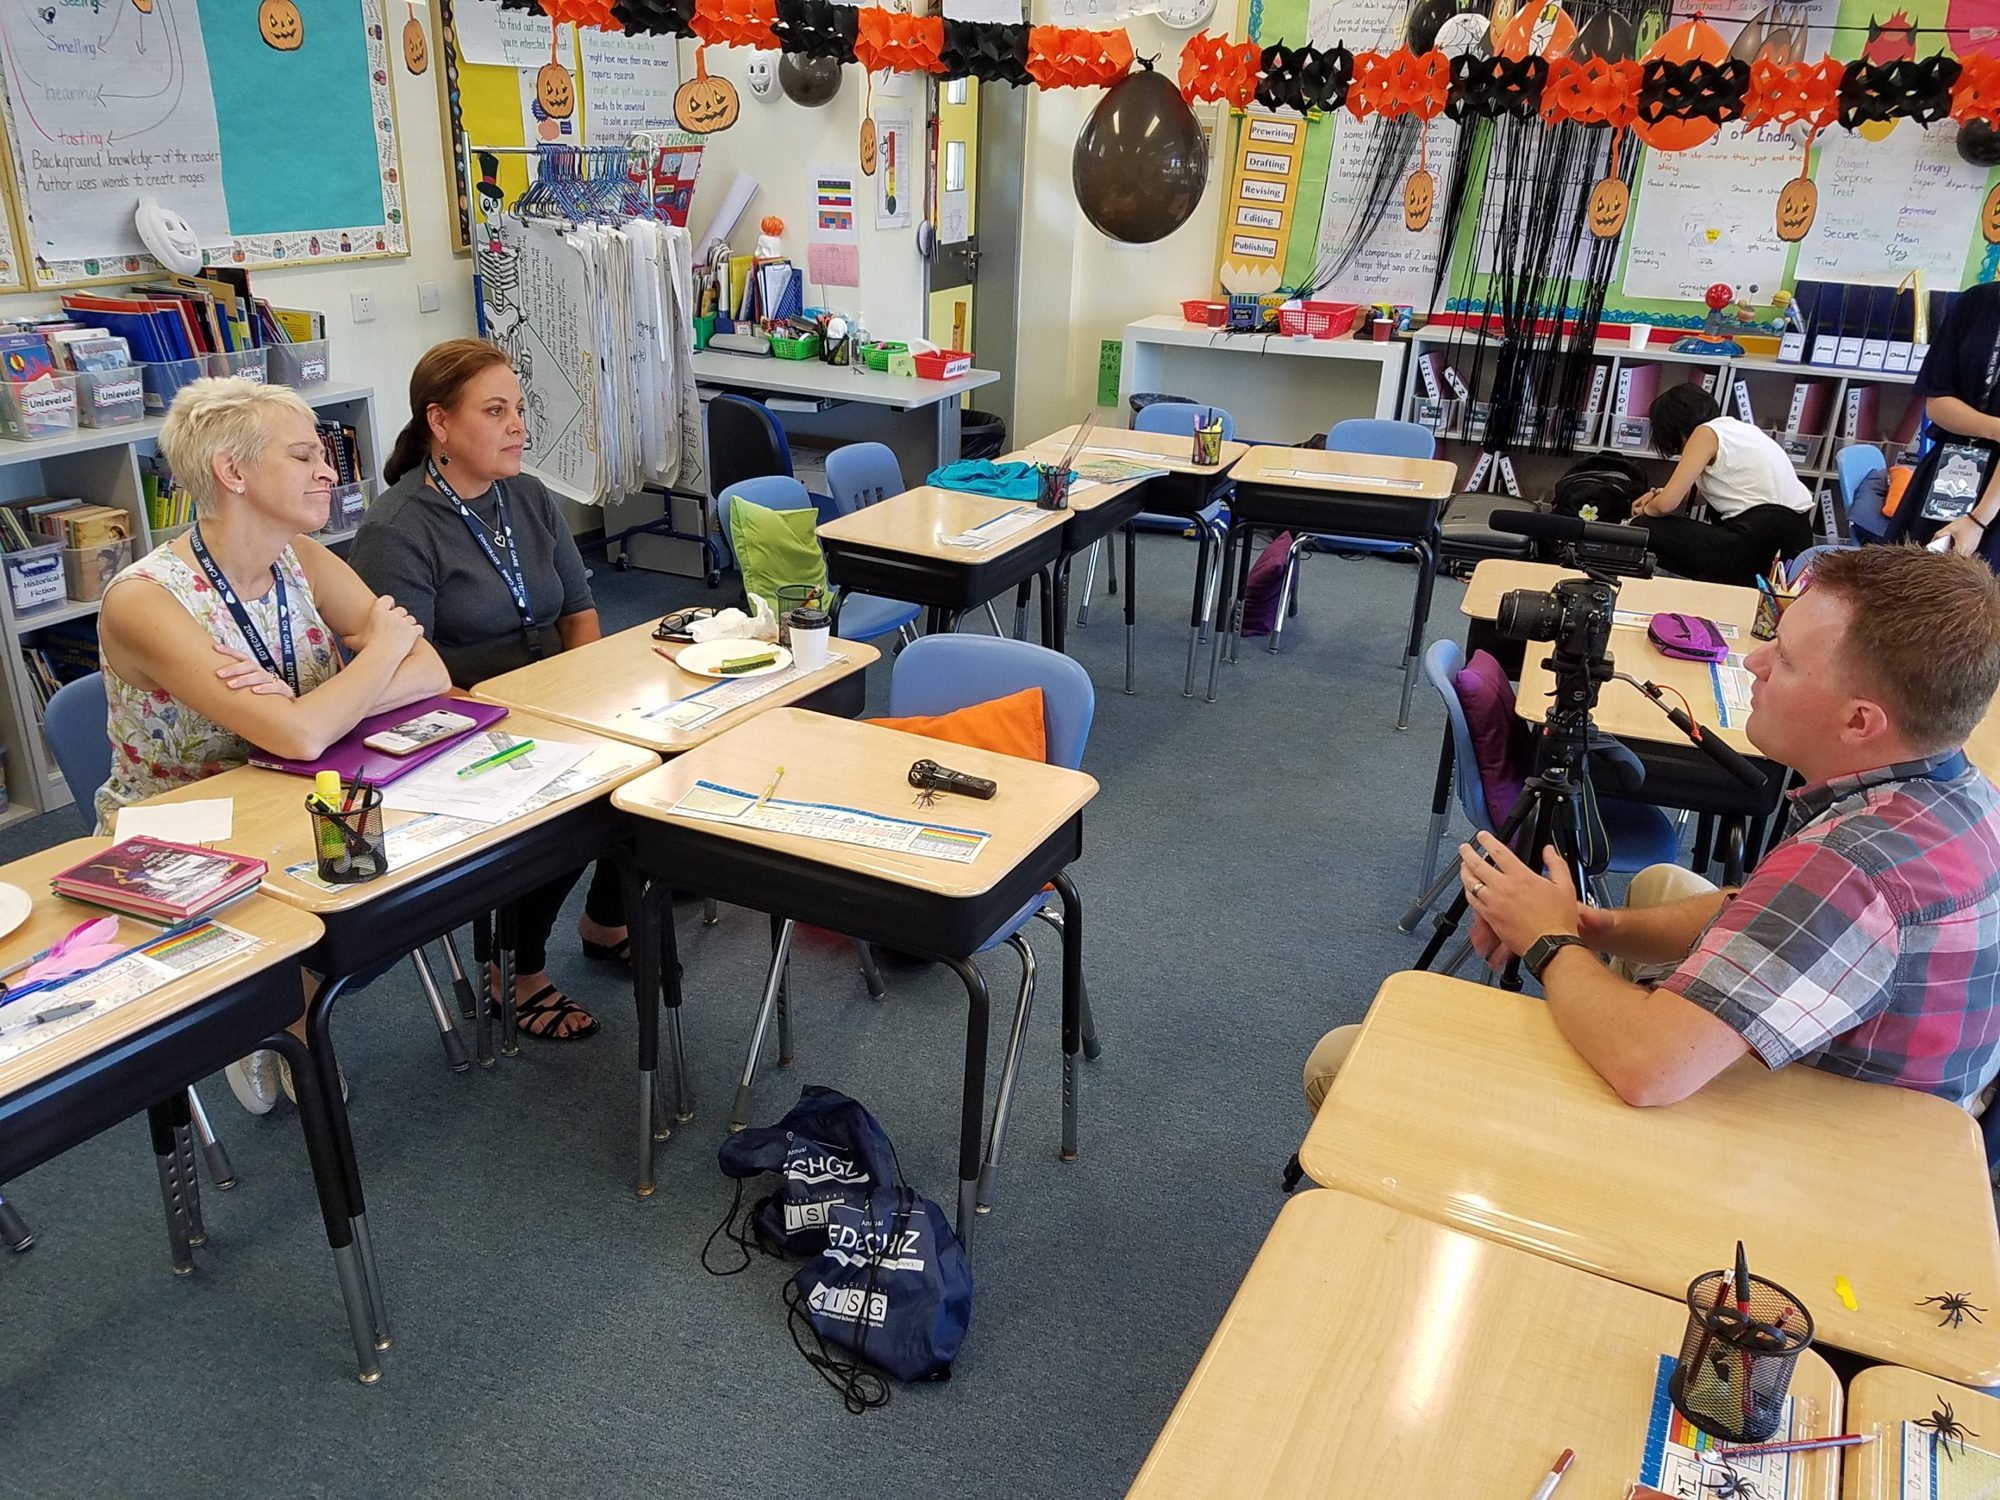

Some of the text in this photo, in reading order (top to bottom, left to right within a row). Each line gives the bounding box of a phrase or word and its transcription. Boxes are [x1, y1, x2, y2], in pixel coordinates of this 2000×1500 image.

[508, 17, 521, 31] find
[523, 21, 534, 32] out
[47, 36, 97, 60] Smelling
[590, 52, 603, 64] might
[604, 52, 615, 63] have
[653, 59, 669, 67] answer
[592, 70, 635, 81] requires research
[624, 101, 645, 111] answered
[596, 132, 615, 144] require
[1251, 127, 1295, 140] Prewriting
[1731, 125, 1746, 140] of
[58, 130, 104, 150] tasting
[32, 149, 101, 174] Background
[161, 149, 173, 164] of
[174, 149, 187, 163] the
[191, 151, 220, 163] reader
[1679, 150, 1687, 158] to
[1691, 151, 1701, 159] do
[1733, 153, 1750, 161] than
[1772, 153, 1785, 161] end
[1789, 152, 1803, 161] the
[1835, 155, 1870, 169] Disgust
[1249, 157, 1285, 170] Drafting
[1411, 161, 1442, 174] sesory
[1658, 162, 1679, 176] story
[1914, 159, 1951, 178] Hungry
[36, 174, 72, 192] Author
[76, 177, 97, 190] uses
[101, 174, 130, 188] words
[134, 173, 144, 182] to
[145, 171, 174, 186] create
[1245, 186, 1281, 199] Revising
[1899, 206, 1937, 216] depressed
[1244, 213, 1274, 225] Editing
[1823, 226, 1860, 240] Secure
[1894, 232, 1920, 244] Mean
[1234, 241, 1274, 255] Publishing
[1365, 250, 1401, 260] comparison
[1404, 250, 1413, 259] of
[1884, 243, 1909, 262] Shy
[1355, 261, 1372, 273] things
[1376, 260, 1390, 271] that
[1814, 256, 1839, 267] Tired
[1365, 272, 1389, 283] another
[240, 369, 259, 378] Earth
[102, 386, 140, 400] Unleveled
[1618, 371, 1629, 412] CHLOE
[29, 394, 72, 408] Unleveled
[1788, 387, 1803, 430] ELISE
[1847, 394, 1858, 437] GAVIN
[438, 479, 462, 506] CN CARE
[508, 539, 520, 568] CN CARE
[202, 556, 227, 591] CN CARE
[23, 575, 60, 590] Historical
[502, 569, 520, 596] CN CARE
[30, 586, 57, 598] Fiction
[281, 620, 289, 632] CN
[283, 633, 292, 655] CARE
[787, 1146, 808, 1156] Annual
[811, 1290, 885, 1317] AISG
